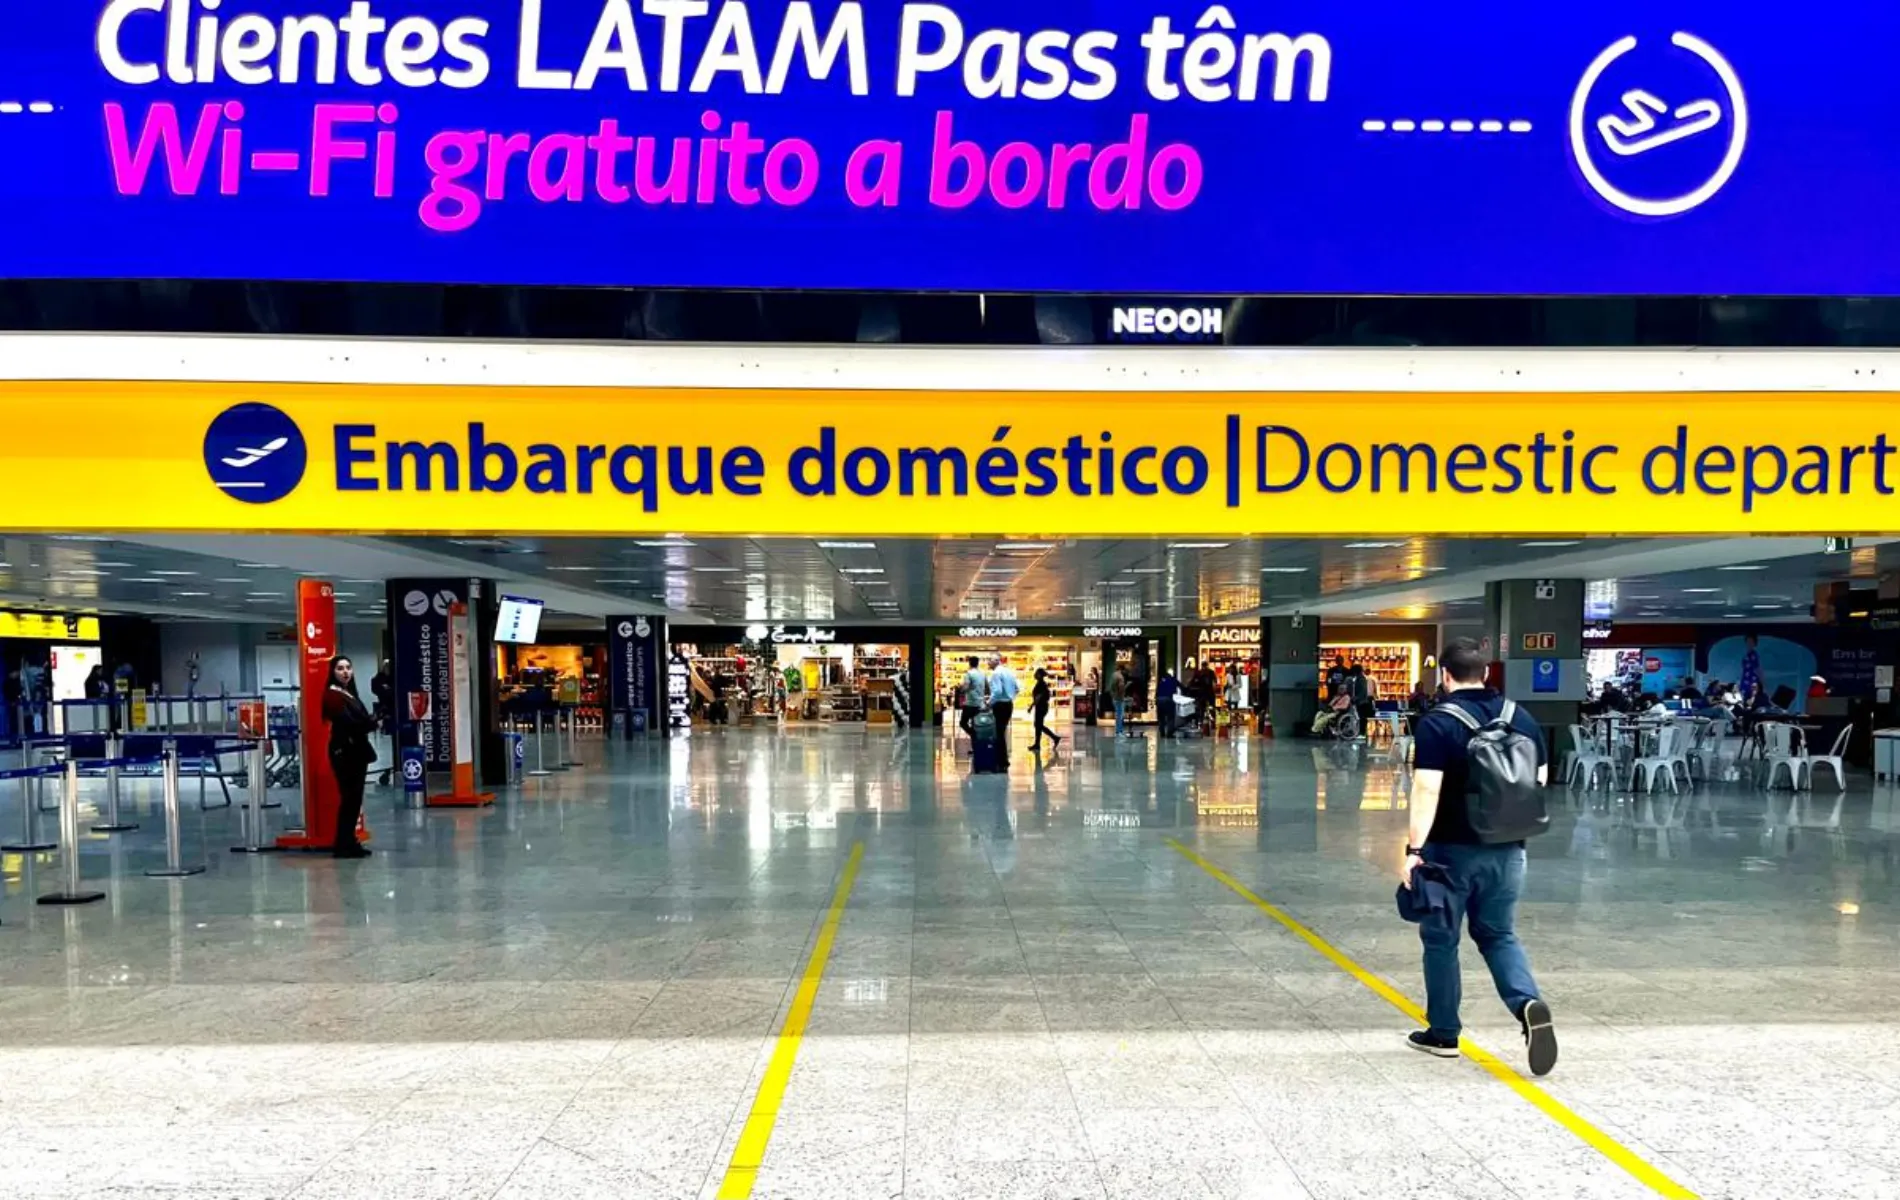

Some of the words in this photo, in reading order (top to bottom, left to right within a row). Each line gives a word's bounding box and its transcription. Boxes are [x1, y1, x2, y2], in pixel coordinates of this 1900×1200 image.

[97, 0, 489, 88] Clientes
[517, 0, 868, 96] LATAM
[896, 3, 1118, 101] Pass
[1140, 5, 1332, 102] têm
[103, 100, 399, 198] Wi-Fi
[418, 109, 820, 232] gratuito
[845, 139, 902, 208] a
[929, 110, 1203, 211] bordo
[1113, 307, 1222, 334] NEOOH
[333, 421, 764, 513] Embarque
[788, 425, 1209, 497] doméstico
[1256, 414, 1619, 495] Domestic
[1641, 424, 1899, 513] depart
[419, 624, 432, 692] doméstico
